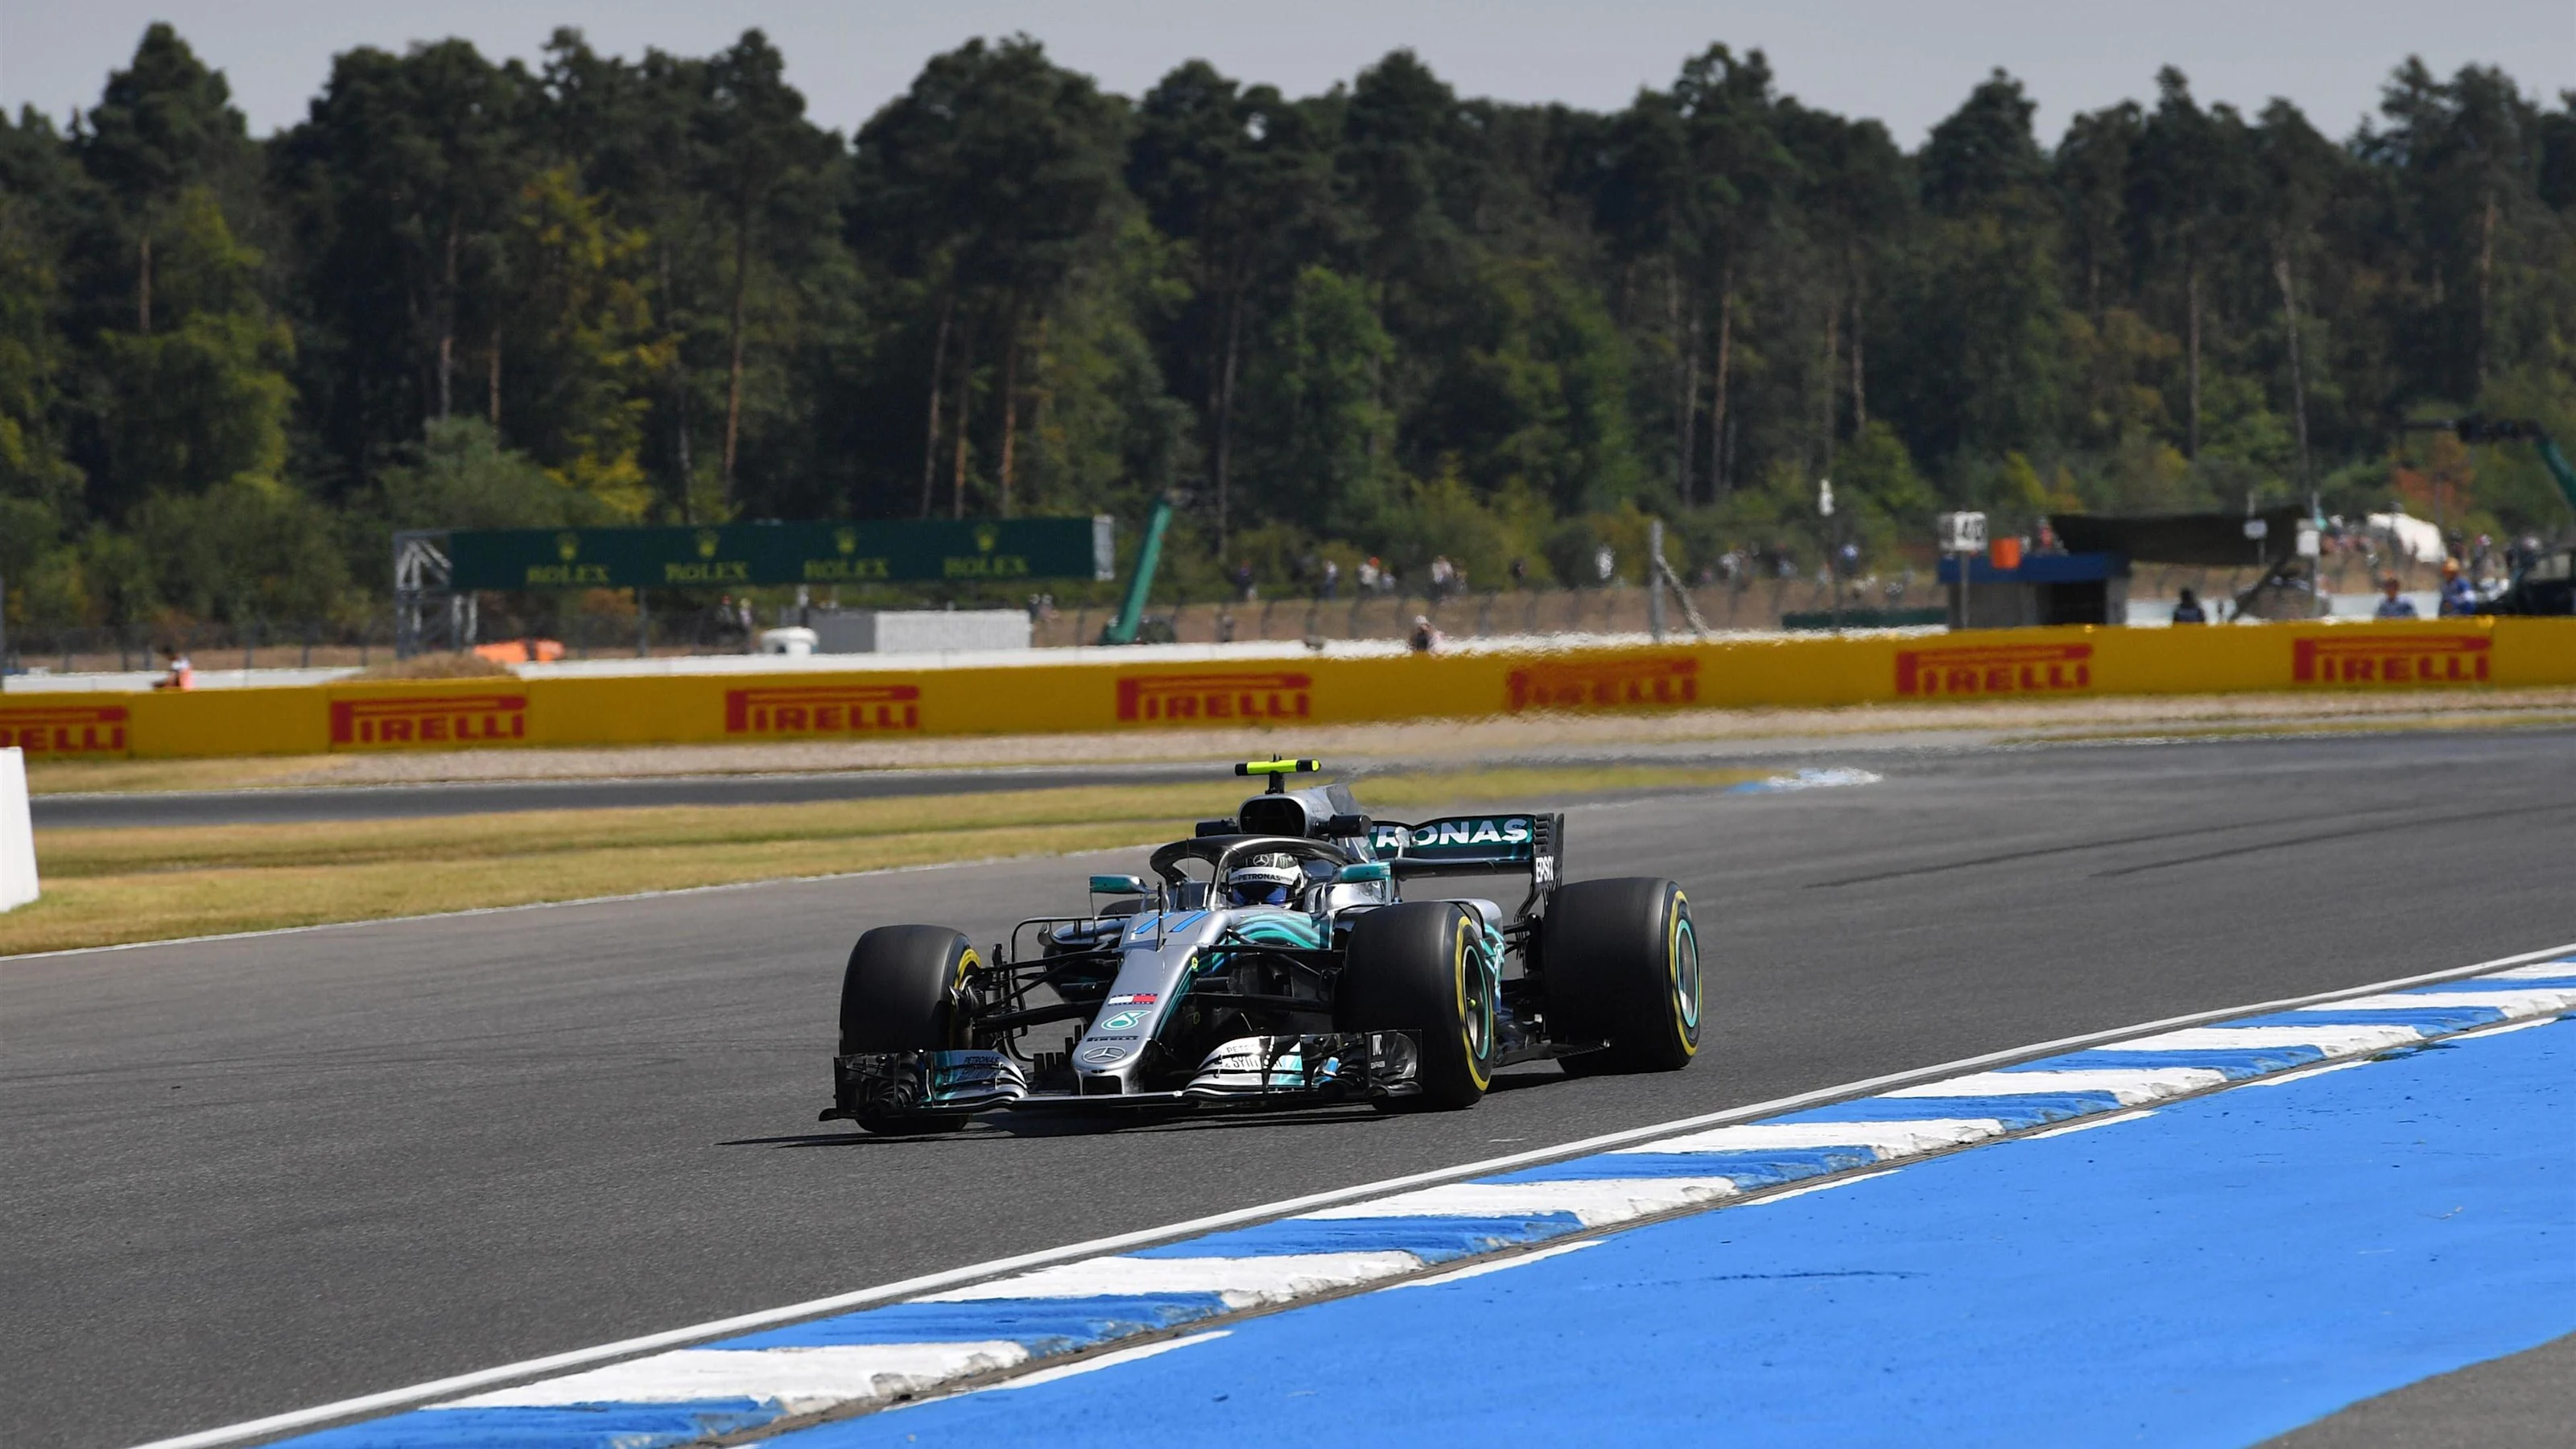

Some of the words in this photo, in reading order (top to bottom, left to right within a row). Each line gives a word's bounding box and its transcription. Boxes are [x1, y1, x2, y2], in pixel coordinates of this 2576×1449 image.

[1897, 643, 2092, 694] PIRELLI
[2293, 635, 2492, 682] PIRELLI
[726, 685, 919, 732] PIRELLI
[1117, 674, 1312, 720] PIRELLI
[1507, 658, 1700, 713] PIRELLI
[331, 696, 527, 743] PIRELLI
[1371, 819, 1529, 848] RONAS
[1238, 873, 1281, 881] PETRONAS
